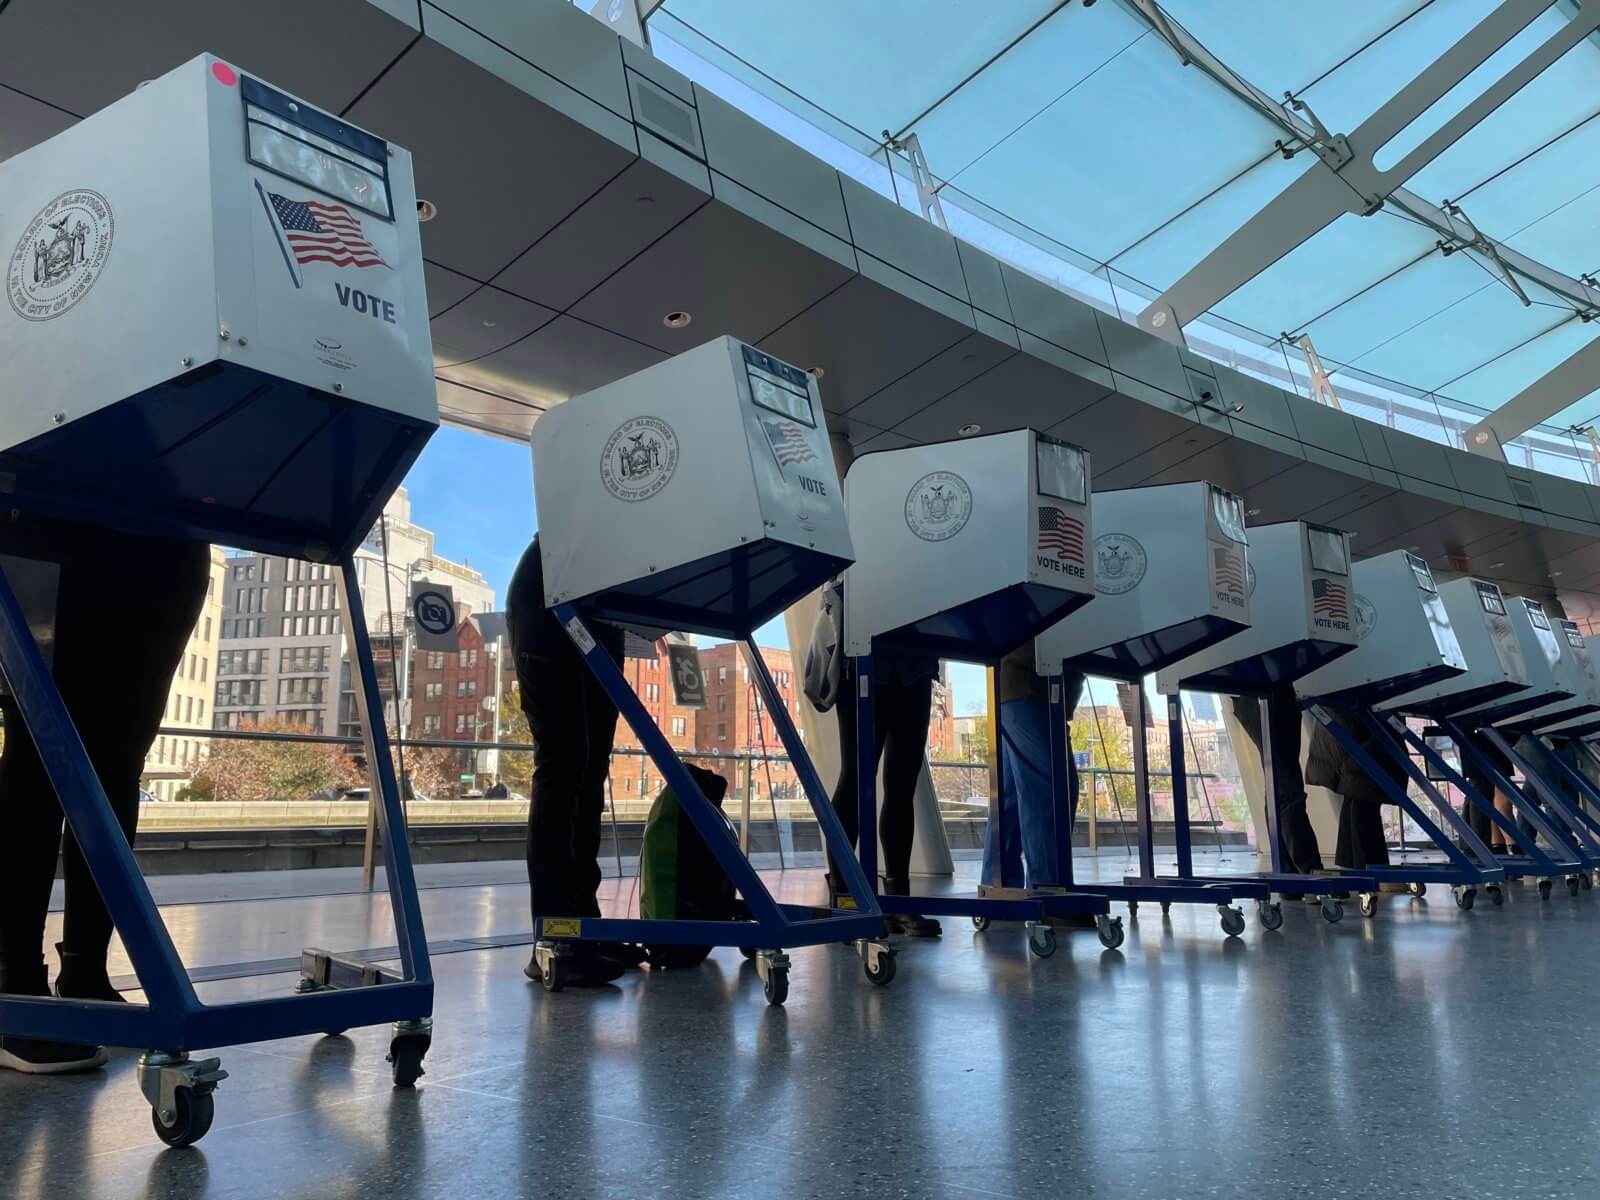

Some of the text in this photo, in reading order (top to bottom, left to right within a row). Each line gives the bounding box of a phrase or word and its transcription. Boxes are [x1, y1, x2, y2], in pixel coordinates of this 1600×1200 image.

[335, 281, 396, 324] VOTE
[797, 474, 827, 496] VOTE
[1037, 555, 1085, 578] VOTE HERE
[1216, 591, 1230, 603] VOTE
[1314, 617, 1350, 631] VOTE HERE
